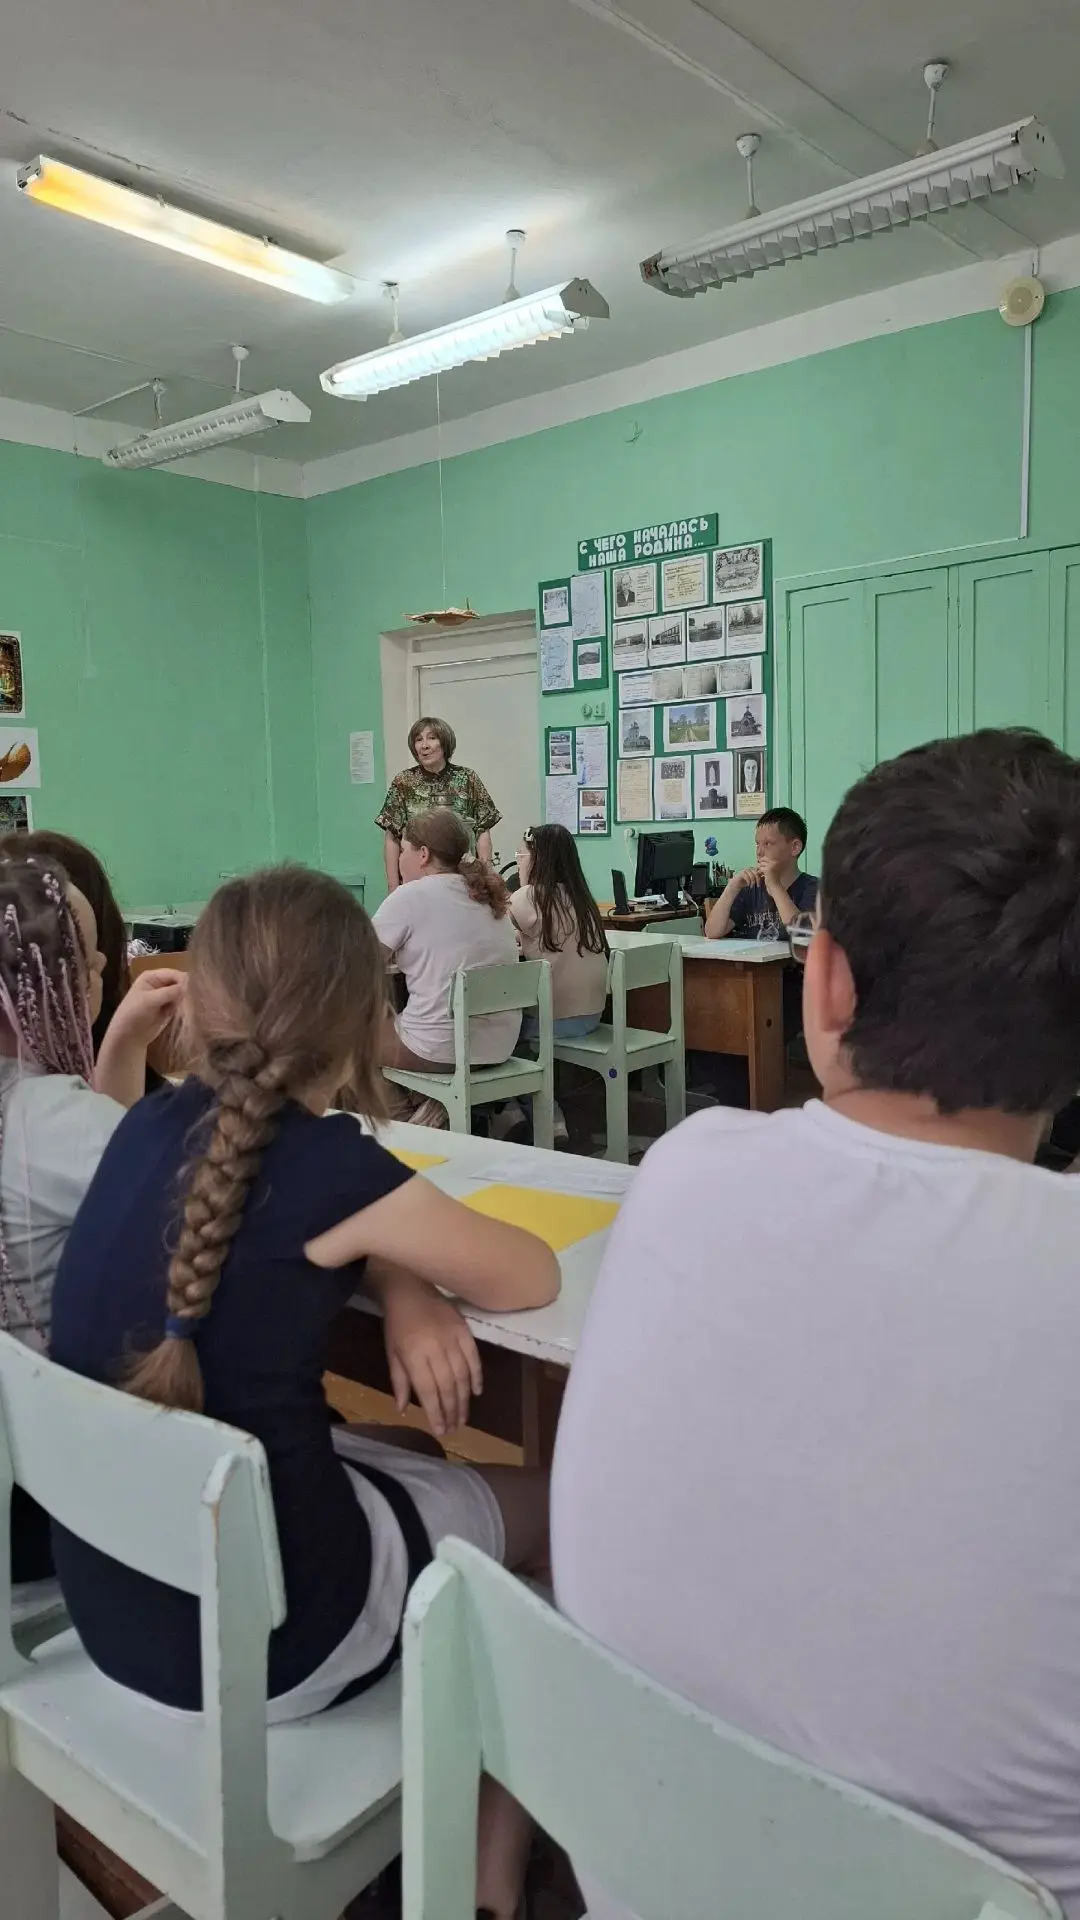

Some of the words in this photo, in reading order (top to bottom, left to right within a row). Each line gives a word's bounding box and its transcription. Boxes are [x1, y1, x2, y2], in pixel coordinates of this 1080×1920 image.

[579, 542, 588, 555] С
[594, 534, 626, 552] ЧЕГО
[633, 517, 709, 544] НАЧАЛАСЬ
[588, 548, 626, 567] НАША
